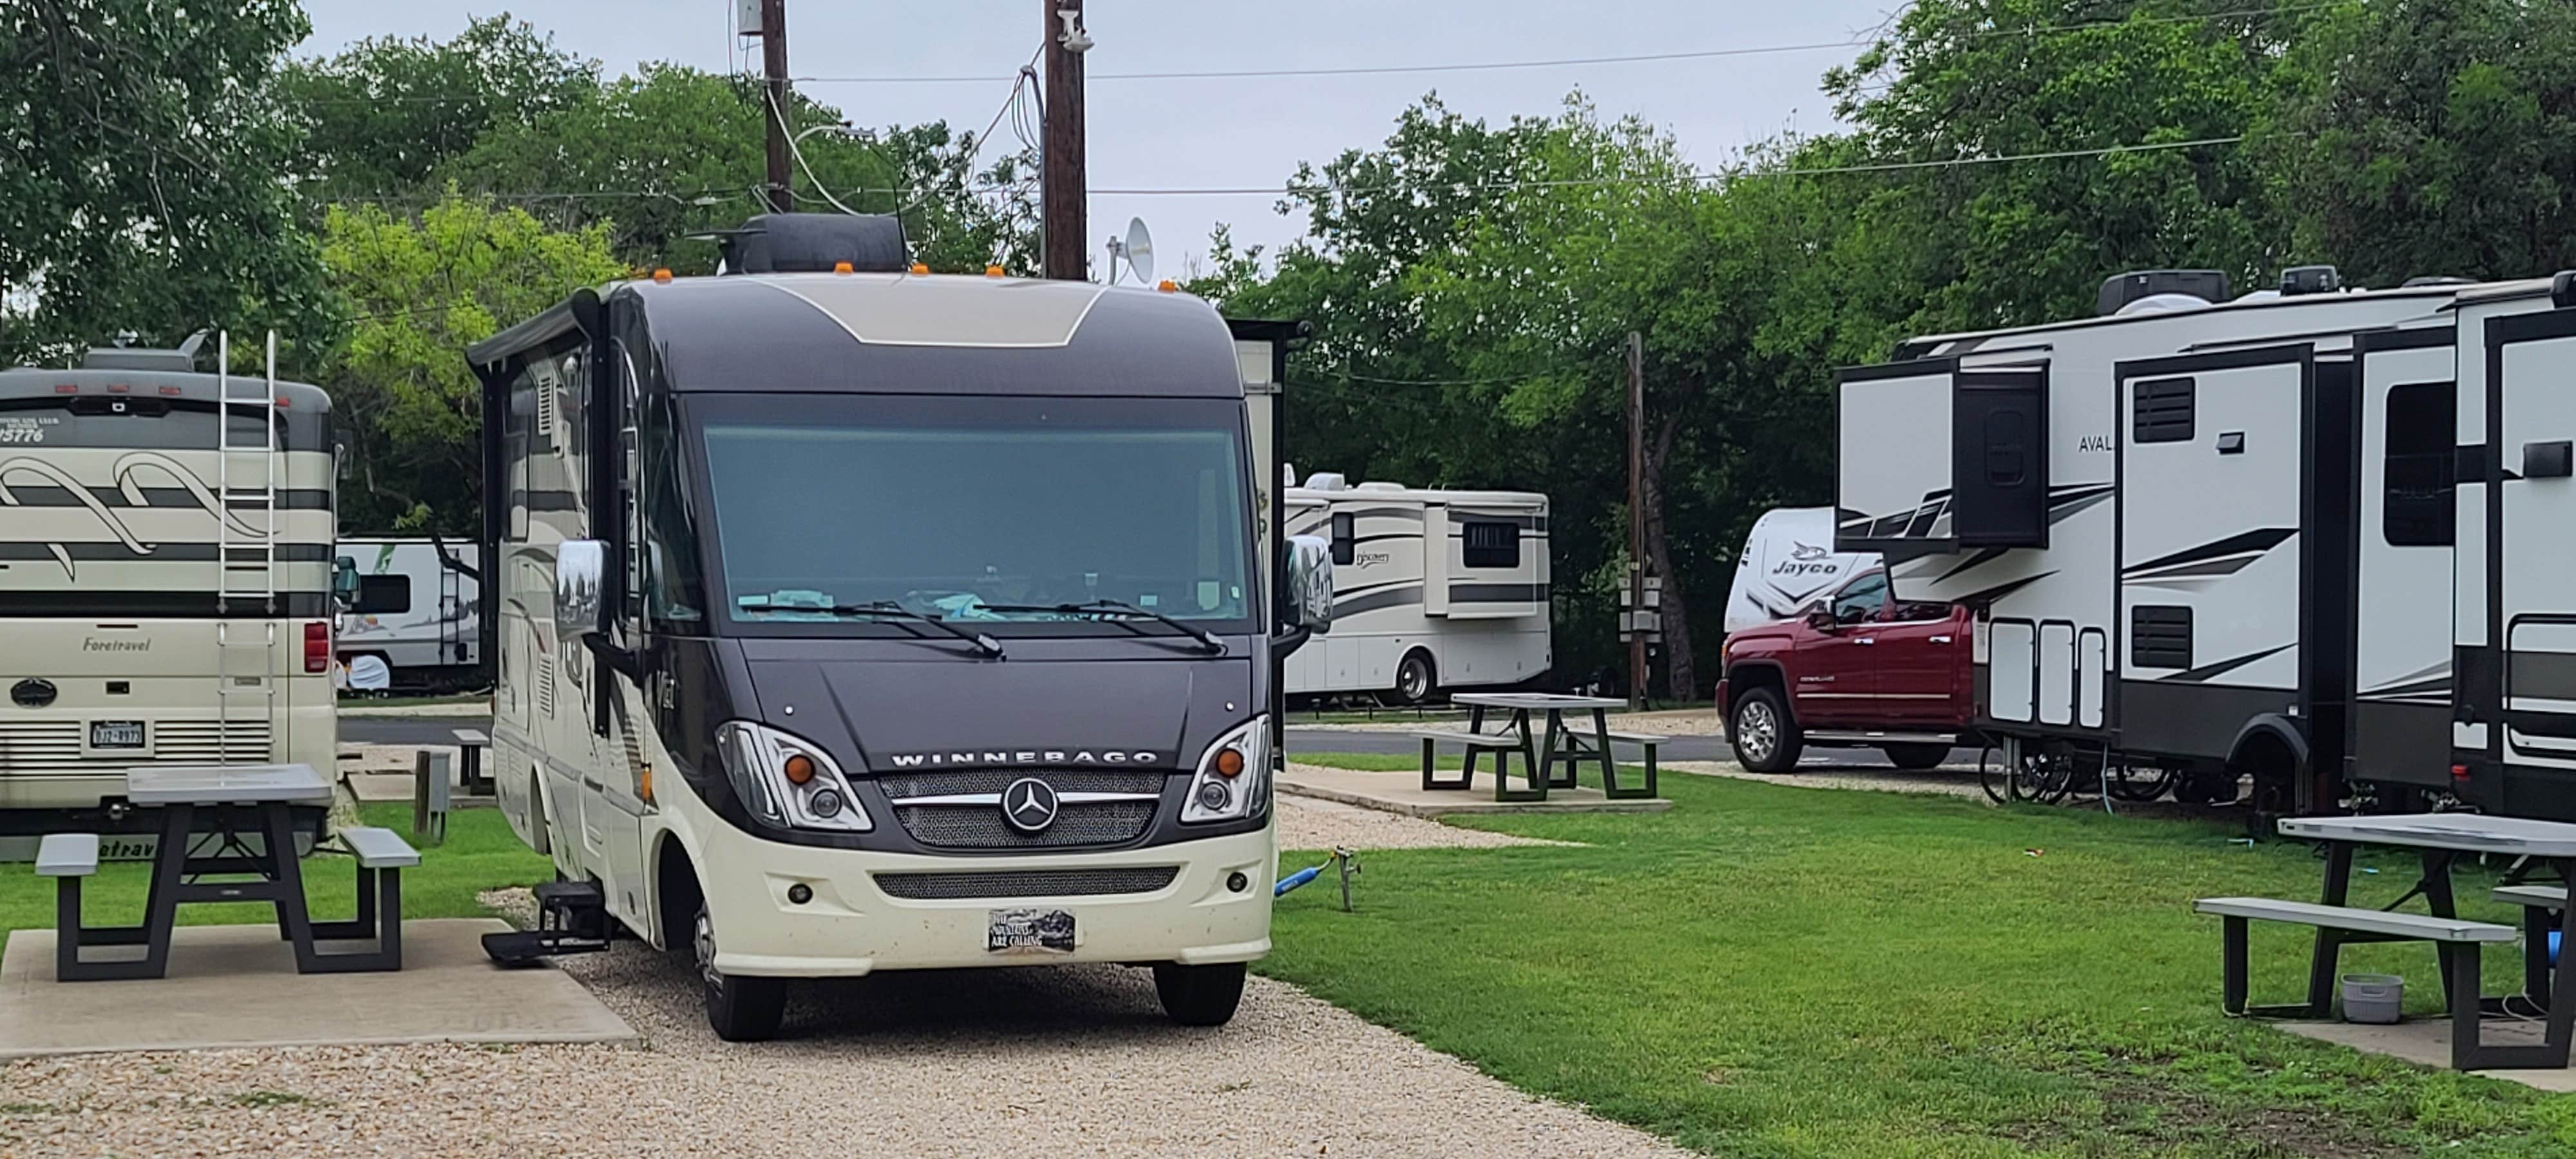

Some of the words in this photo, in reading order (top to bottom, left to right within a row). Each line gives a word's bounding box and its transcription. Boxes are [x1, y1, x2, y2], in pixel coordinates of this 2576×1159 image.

[2078, 435, 2113, 453] AVAL
[1772, 560, 1837, 578] Jayco
[82, 636, 151, 652] Foretravel
[891, 751, 1158, 766] WINNEBAGO
[99, 840, 155, 857] etrav
[991, 935, 1008, 947] ARE
[1009, 934, 1043, 947] CALLING
